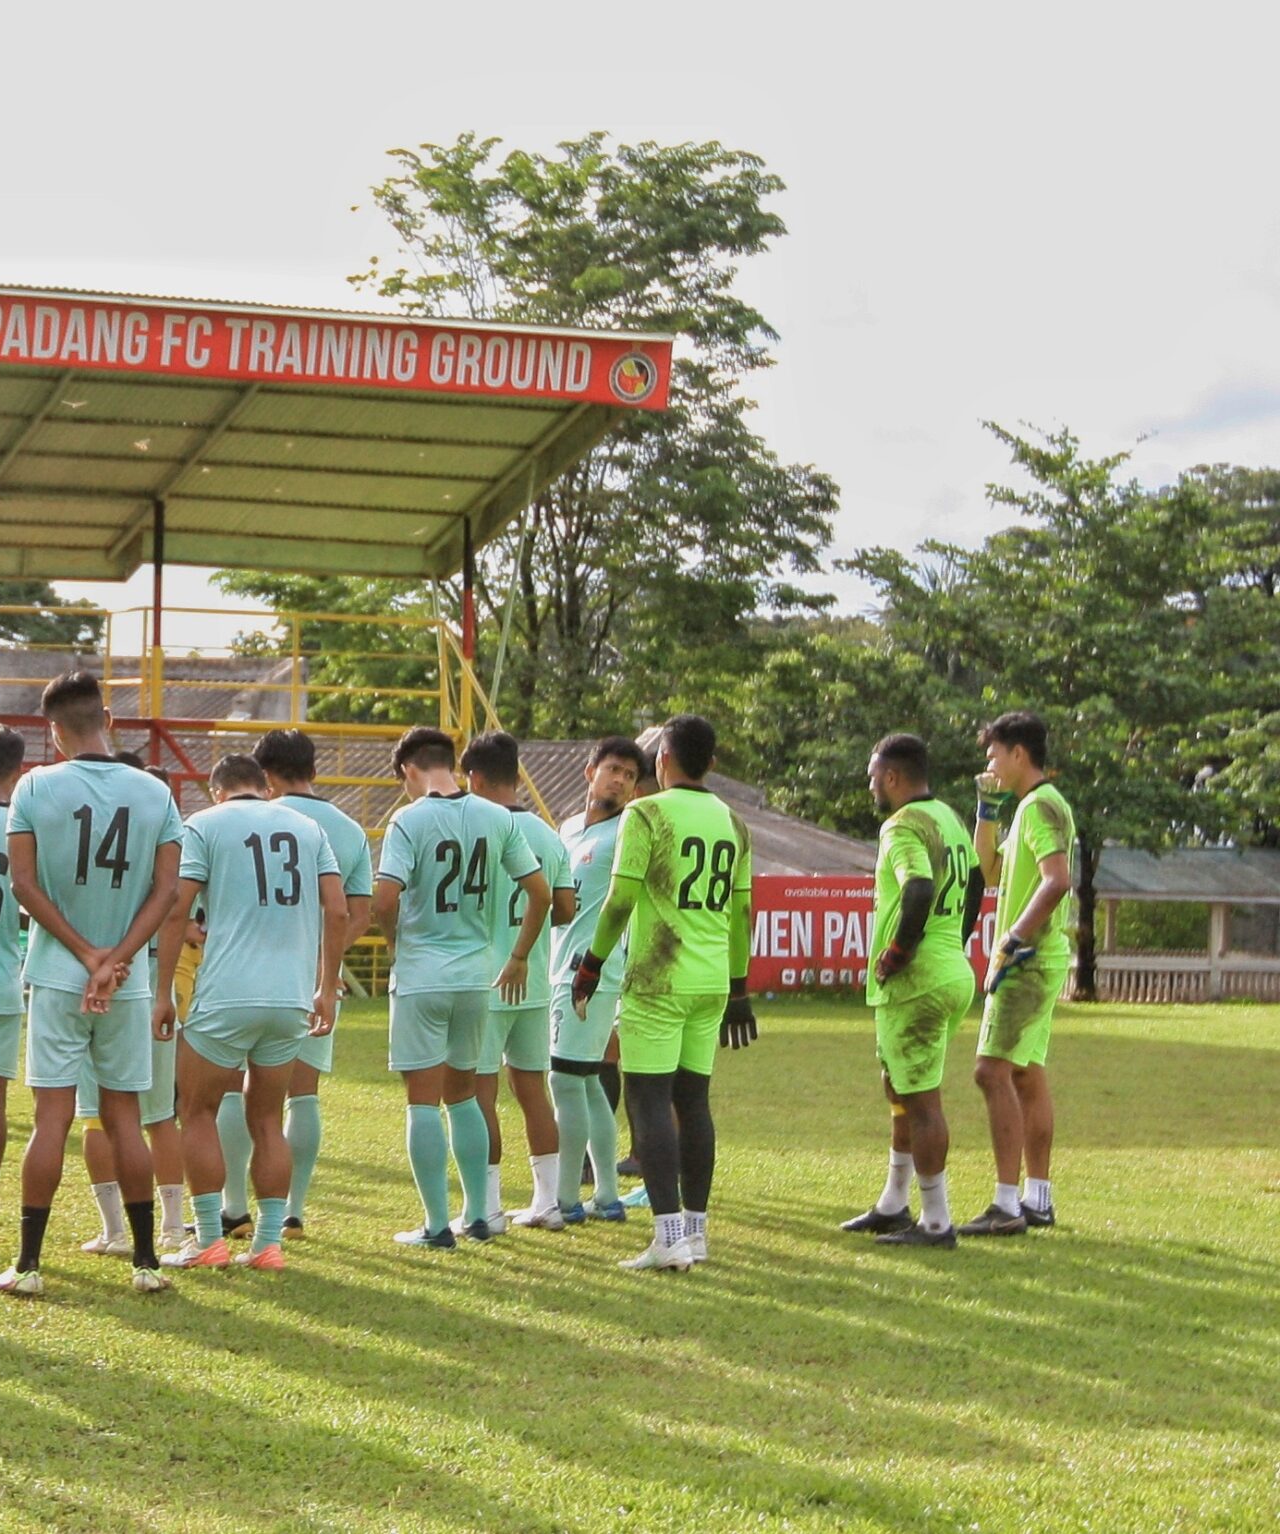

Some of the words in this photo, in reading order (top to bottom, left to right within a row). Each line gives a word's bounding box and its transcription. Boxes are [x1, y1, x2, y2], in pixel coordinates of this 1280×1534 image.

[160, 314, 212, 369] FC
[225, 317, 418, 382] TRAINING
[429, 333, 592, 392] GROUND
[73, 803, 131, 889] 14
[244, 831, 301, 907] 13
[435, 836, 488, 914] 24
[677, 836, 736, 912] 28
[784, 887, 829, 897] available
[830, 888, 843, 897] on
